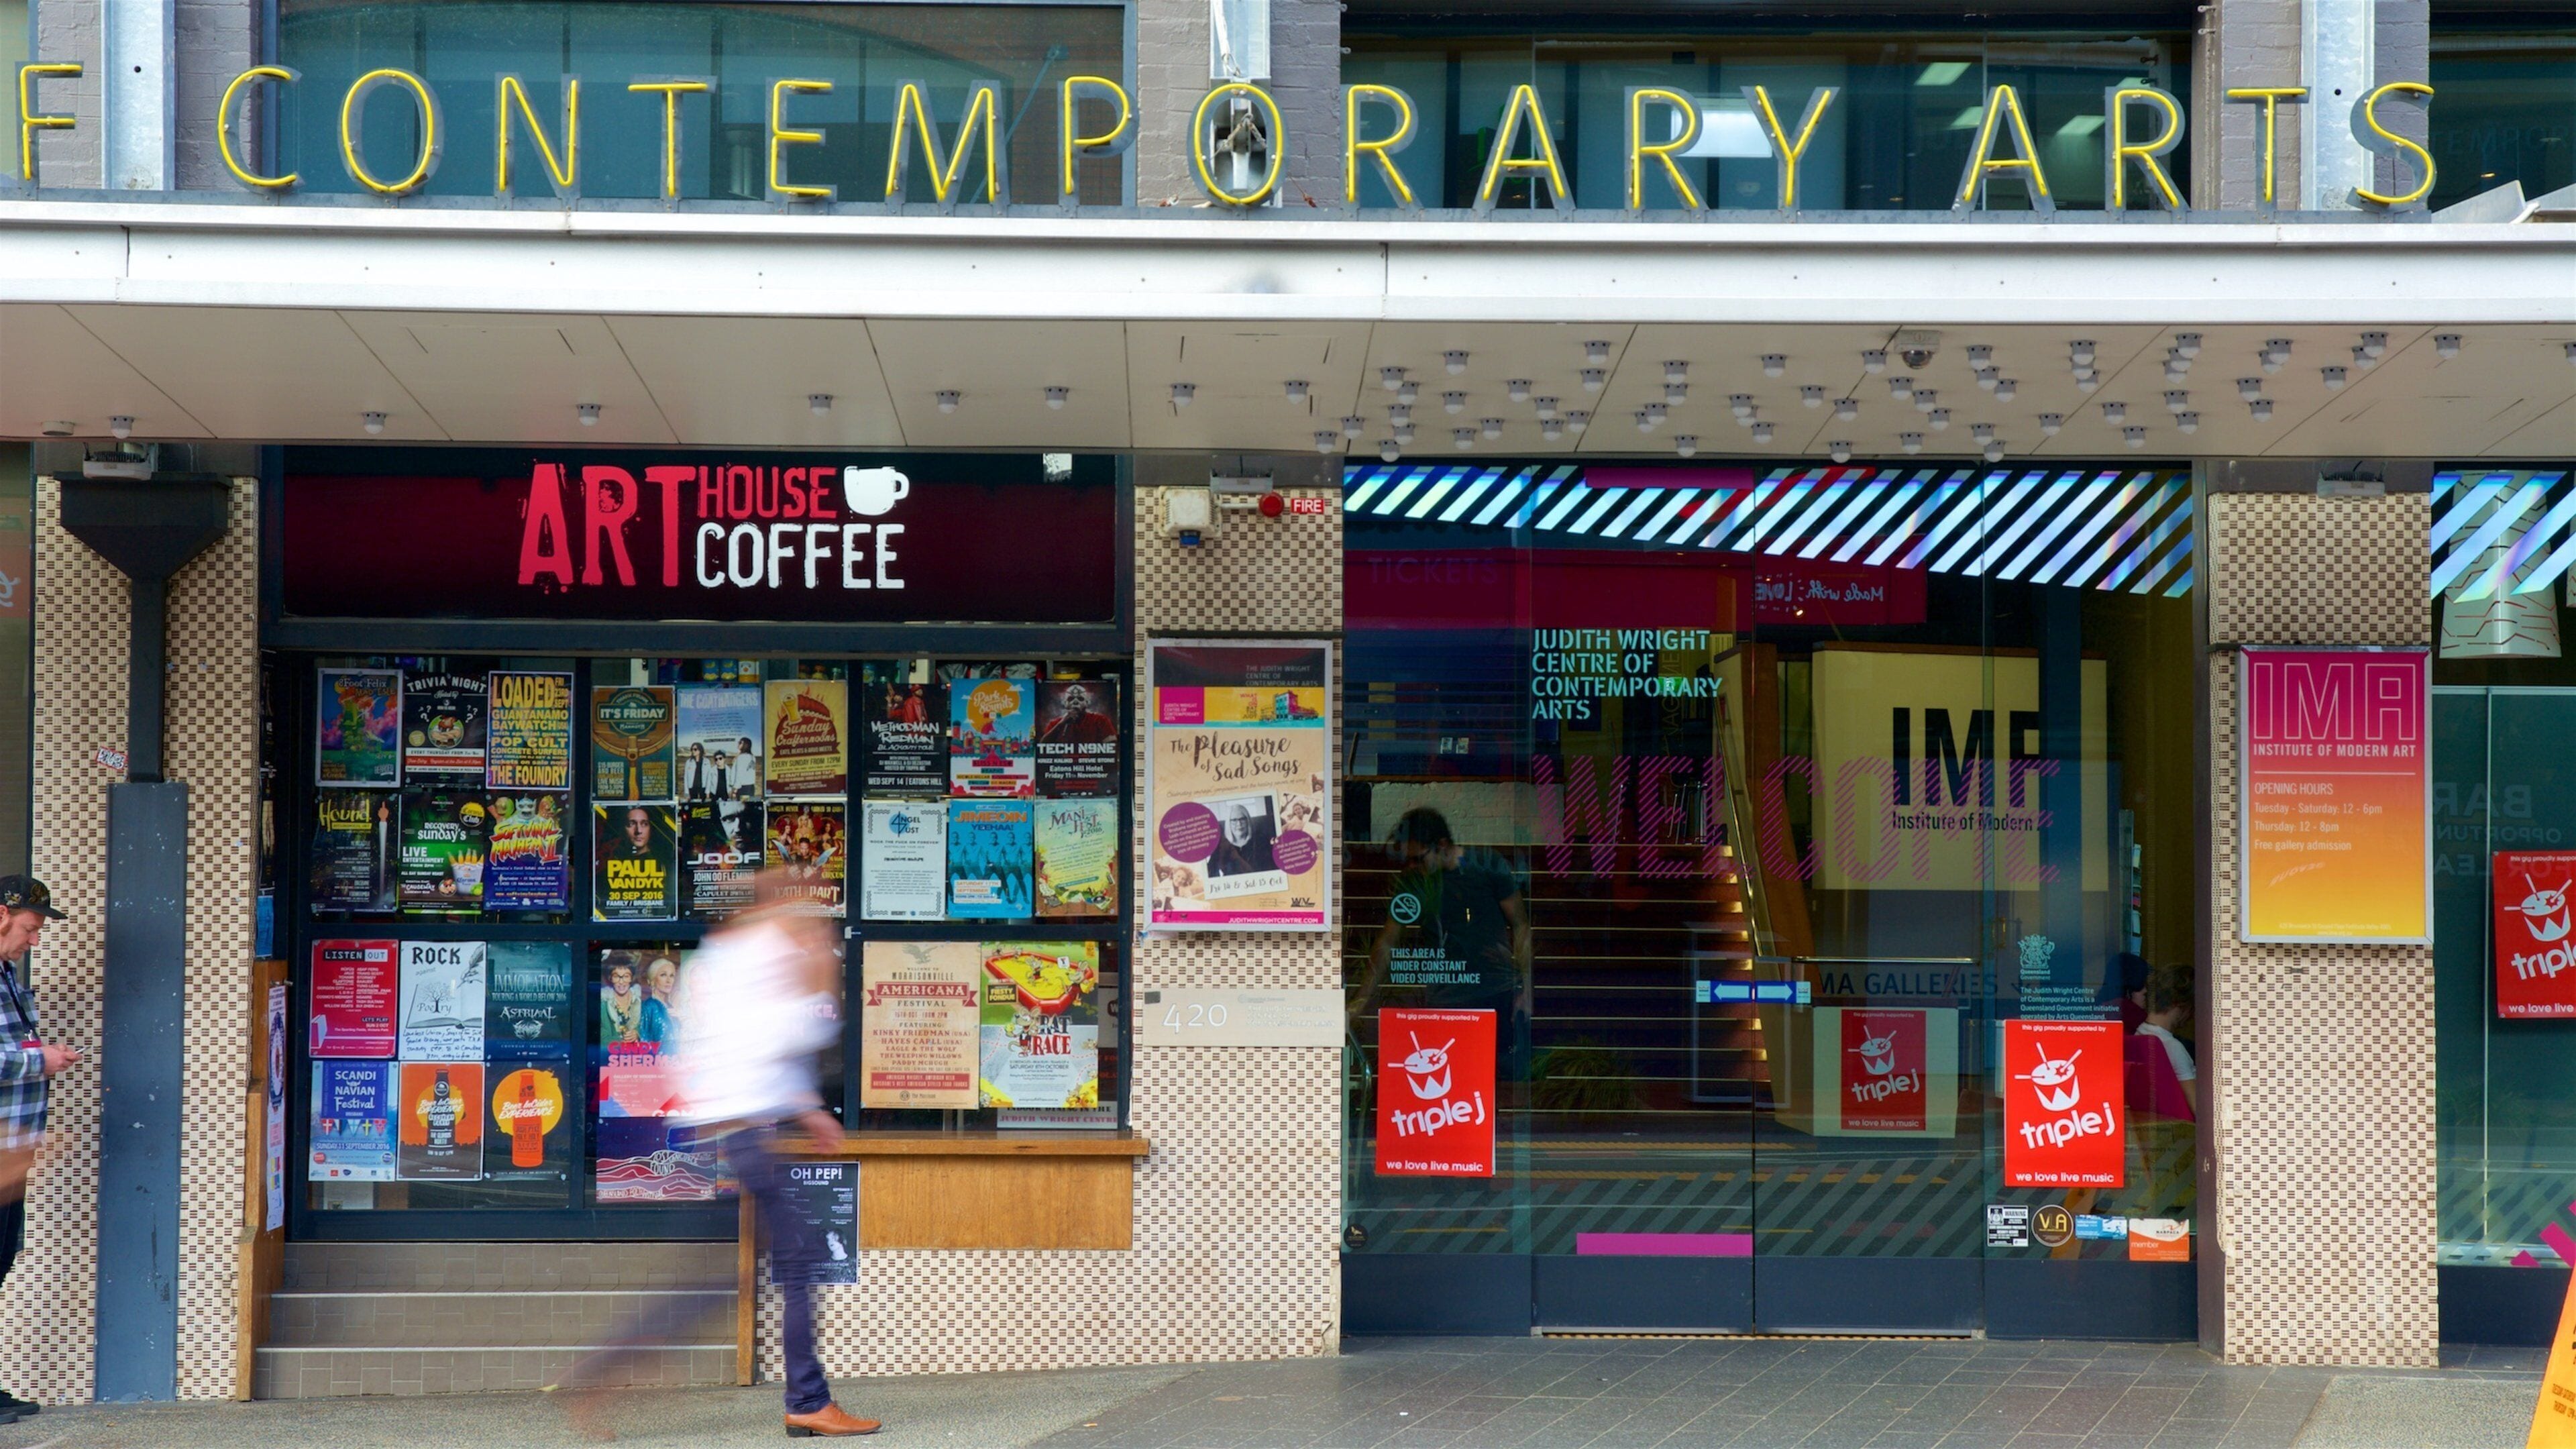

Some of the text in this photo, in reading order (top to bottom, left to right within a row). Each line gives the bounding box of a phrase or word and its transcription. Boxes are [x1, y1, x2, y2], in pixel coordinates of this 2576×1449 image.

[16, 62, 2436, 209] F CONTEMPORARY ARTS
[1293, 499, 1322, 513] FIRE
[518, 463, 838, 586] ART HOUSE
[696, 521, 905, 589] COFFEE
[1368, 557, 1498, 584] TICKETS
[1533, 629, 1711, 652] JUDITH WRIGHT
[1532, 653, 1654, 673] CENTRE OF
[407, 676, 487, 693] TRIVIA NIGHT
[1532, 676, 1723, 698] CONTEMPORARY
[492, 676, 555, 708] LOADED
[2254, 662, 2416, 740] IMA
[492, 709, 569, 720] GUANTANAMO
[600, 708, 665, 718] IT'S FRIDAY
[1532, 699, 1591, 720] ARTS
[492, 720, 557, 730] BAYWATCH
[782, 718, 832, 735] Sunday
[491, 737, 568, 747] POP CULT
[776, 733, 836, 747] Crafternoons
[878, 731, 934, 745] REDMAN
[1036, 743, 1116, 754] TECH N9NE
[1171, 731, 1291, 767] The Pleasure
[2254, 743, 2416, 757] INSTITUTE OF MODERN ART
[771, 760, 788, 769] EVERY
[789, 759, 808, 767] SUNDAY
[1201, 756, 1300, 781] of Sad Songs
[491, 765, 568, 786] THE FOUNDRY
[2254, 782, 2334, 794] OPENING HOURS
[2255, 803, 2383, 815] Tuesday Saturday: 12 6pm
[954, 810, 1028, 823] JIMEOIN
[1533, 755, 2061, 881] WELCOME
[1893, 812, 2033, 830] Institute of Modern
[2255, 821, 2340, 833] Thursday: 12 8pm
[402, 847, 428, 857] LIVE
[2255, 840, 2352, 851] Free gallery admission
[687, 852, 761, 865] JOOF
[606, 859, 665, 877] PAUL
[607, 878, 664, 889] VAN DYK
[693, 873, 711, 881] JOHN
[608, 892, 663, 900] 30 SEP 2016
[325, 951, 385, 959] LISTEN OUT
[412, 947, 460, 964] ROCK
[1391, 948, 1446, 959] THIS AREA IS
[1390, 961, 1467, 971] UNDER CONSTANT
[494, 974, 565, 992] IMMOLATION
[892, 972, 953, 980] MORRISONVILLE
[1390, 973, 1481, 984] VIDEO SURVEILLANCE
[881, 985, 965, 996] AMERICANA
[1864, 973, 1998, 996] GALLERIES
[2528, 1004, 2552, 1013] love
[2555, 1004, 2574, 1013] live
[1038, 1015, 1072, 1034] RAT
[1162, 1004, 1228, 1034] 420
[607, 1041, 660, 1054] CINDY
[1031, 1035, 1071, 1055] RACE
[335, 1071, 376, 1080] SCANDI
[335, 1086, 375, 1095] NAVIAN
[334, 1097, 375, 1112] Festival
[1391, 1091, 1485, 1137] triple j
[2019, 1102, 2115, 1149] triple j
[790, 1168, 843, 1179] OH PEP!
[1386, 1161, 1484, 1172] we love live music
